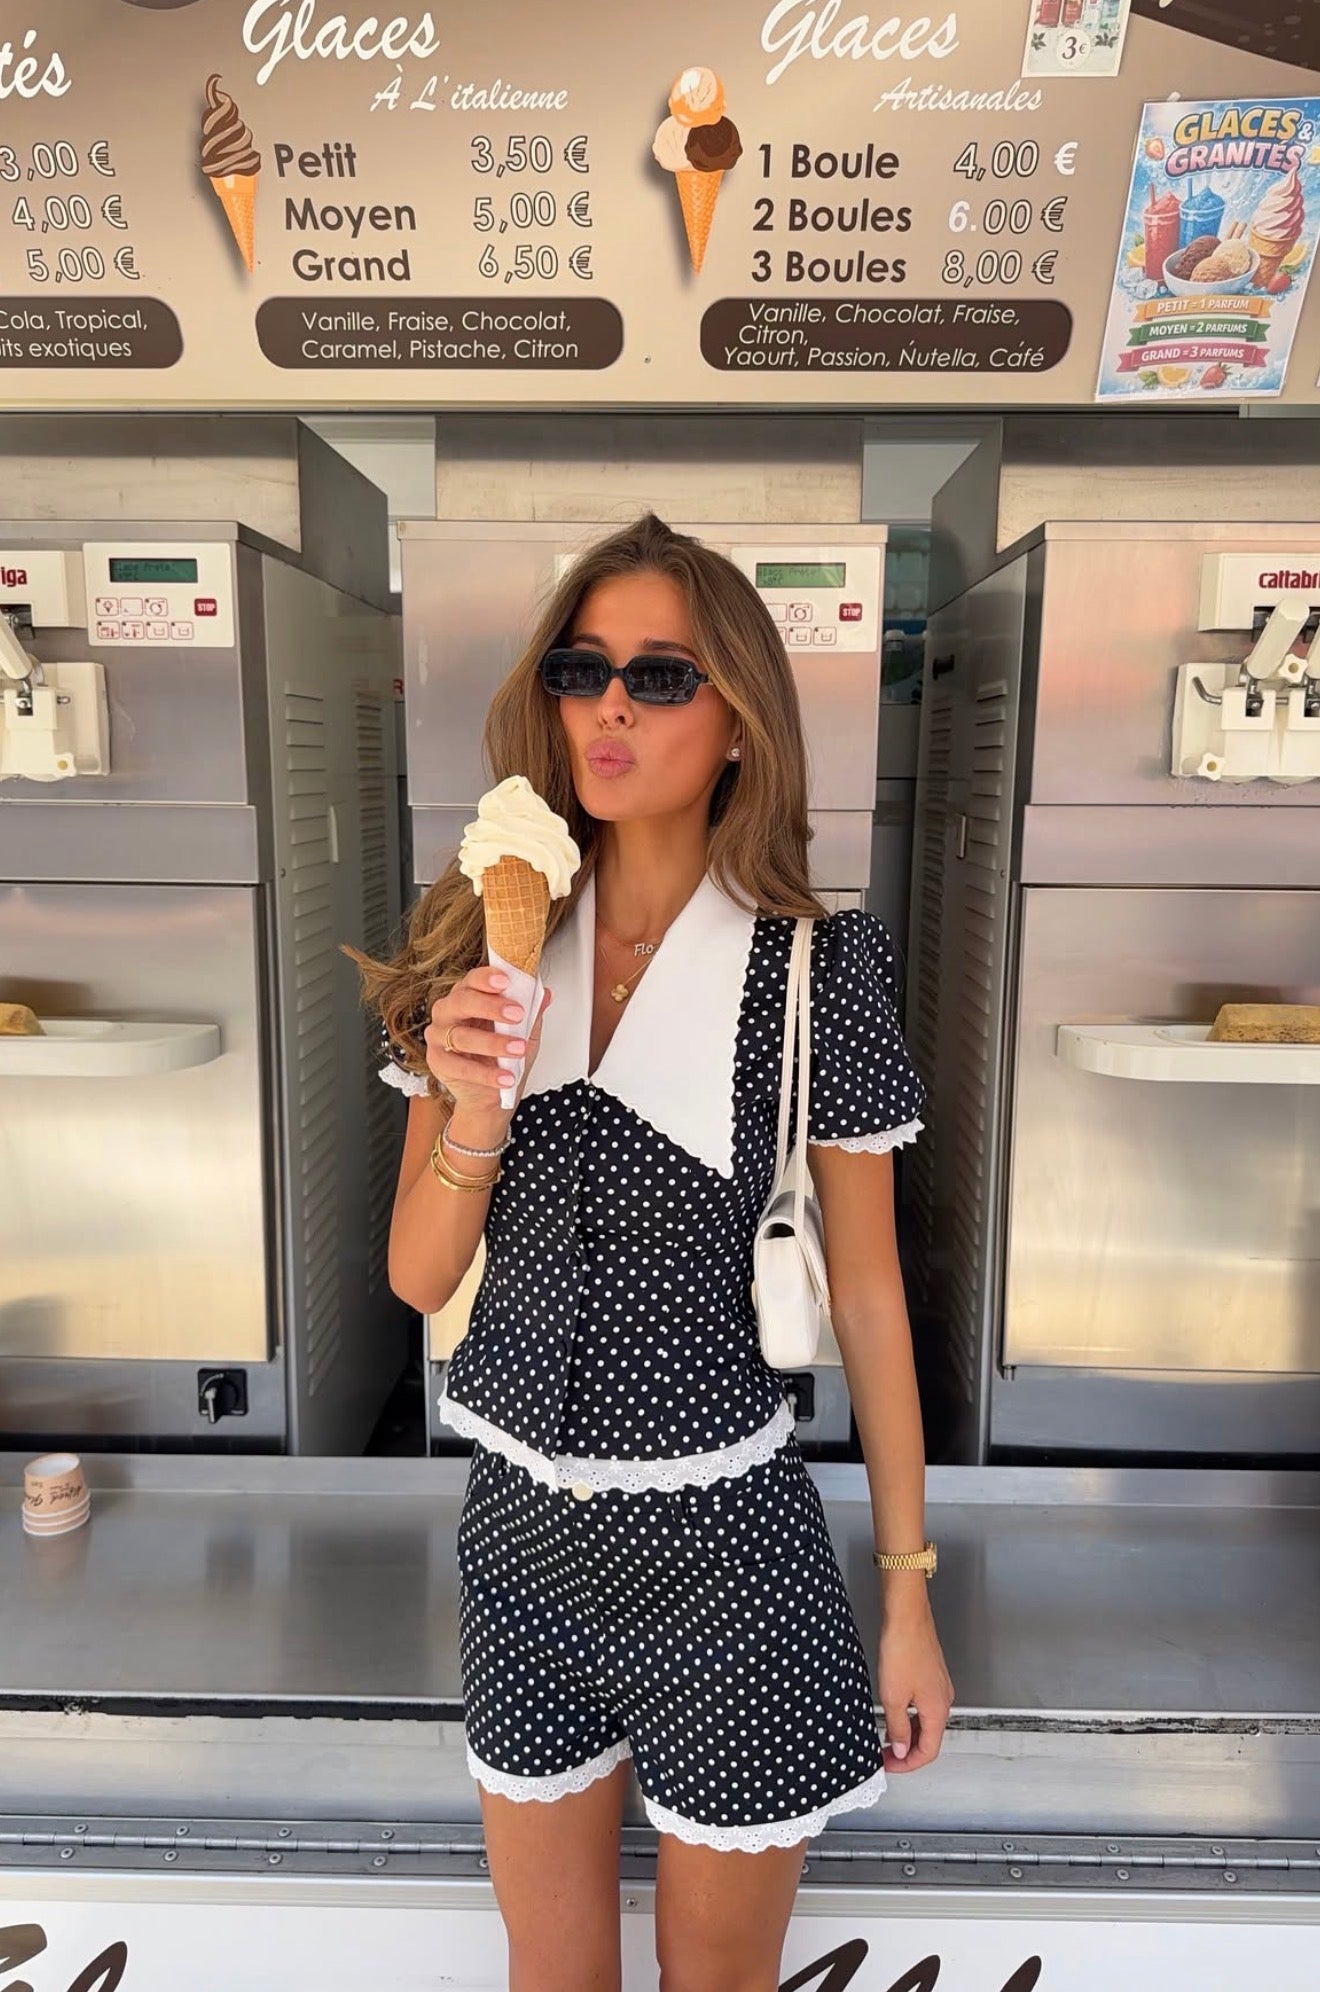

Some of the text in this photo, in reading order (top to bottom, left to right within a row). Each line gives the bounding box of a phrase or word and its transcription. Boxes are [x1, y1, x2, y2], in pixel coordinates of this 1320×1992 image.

[243, 0, 440, 86] Glaces
[761, 0, 959, 85] Glaces
[873, 76, 1043, 112] Artisanales
[1174, 107, 1302, 146] GLACES
[0, 140, 116, 182] 3,00 €
[273, 135, 589, 178] Petit 3,50 €
[758, 140, 1079, 182] 1 Boule 4,00 €
[1165, 139, 1305, 178] GRANITÉS
[12, 194, 128, 234] 4,00 €
[285, 191, 592, 238] Moyen 5,00 €
[752, 196, 1068, 235] 2 Boules 6.00 €
[26, 246, 141, 283] 5,00 €
[292, 244, 593, 283] Grand 6,50 €
[751, 249, 1059, 289] 3 Boules 8,00 €
[54, 309, 148, 332] Tropical,
[301, 311, 572, 333] Vanille, Fraise, Chocolat,
[749, 303, 1021, 327] Vanille, Chocolat, Fraise,
[1157, 300, 1189, 314] PETIT
[1209, 299, 1249, 309] PARFUM
[738, 325, 809, 346] Citron,
[1149, 323, 1188, 336] MOYEN
[1196, 322, 1204, 333] 2
[1205, 323, 1248, 333] PARFUMS
[28, 338, 132, 361] exotiques
[301, 339, 579, 361] Caramel, Pistache, Citron
[724, 347, 799, 367] Yaourt,
[807, 347, 891, 367] Passion,
[1141, 348, 1181, 361] GRAND
[1190, 346, 1199, 358] 3
[1200, 348, 1245, 359] PARFUMS
[197, 602, 216, 614] STOP
[842, 606, 861, 617] STOP
